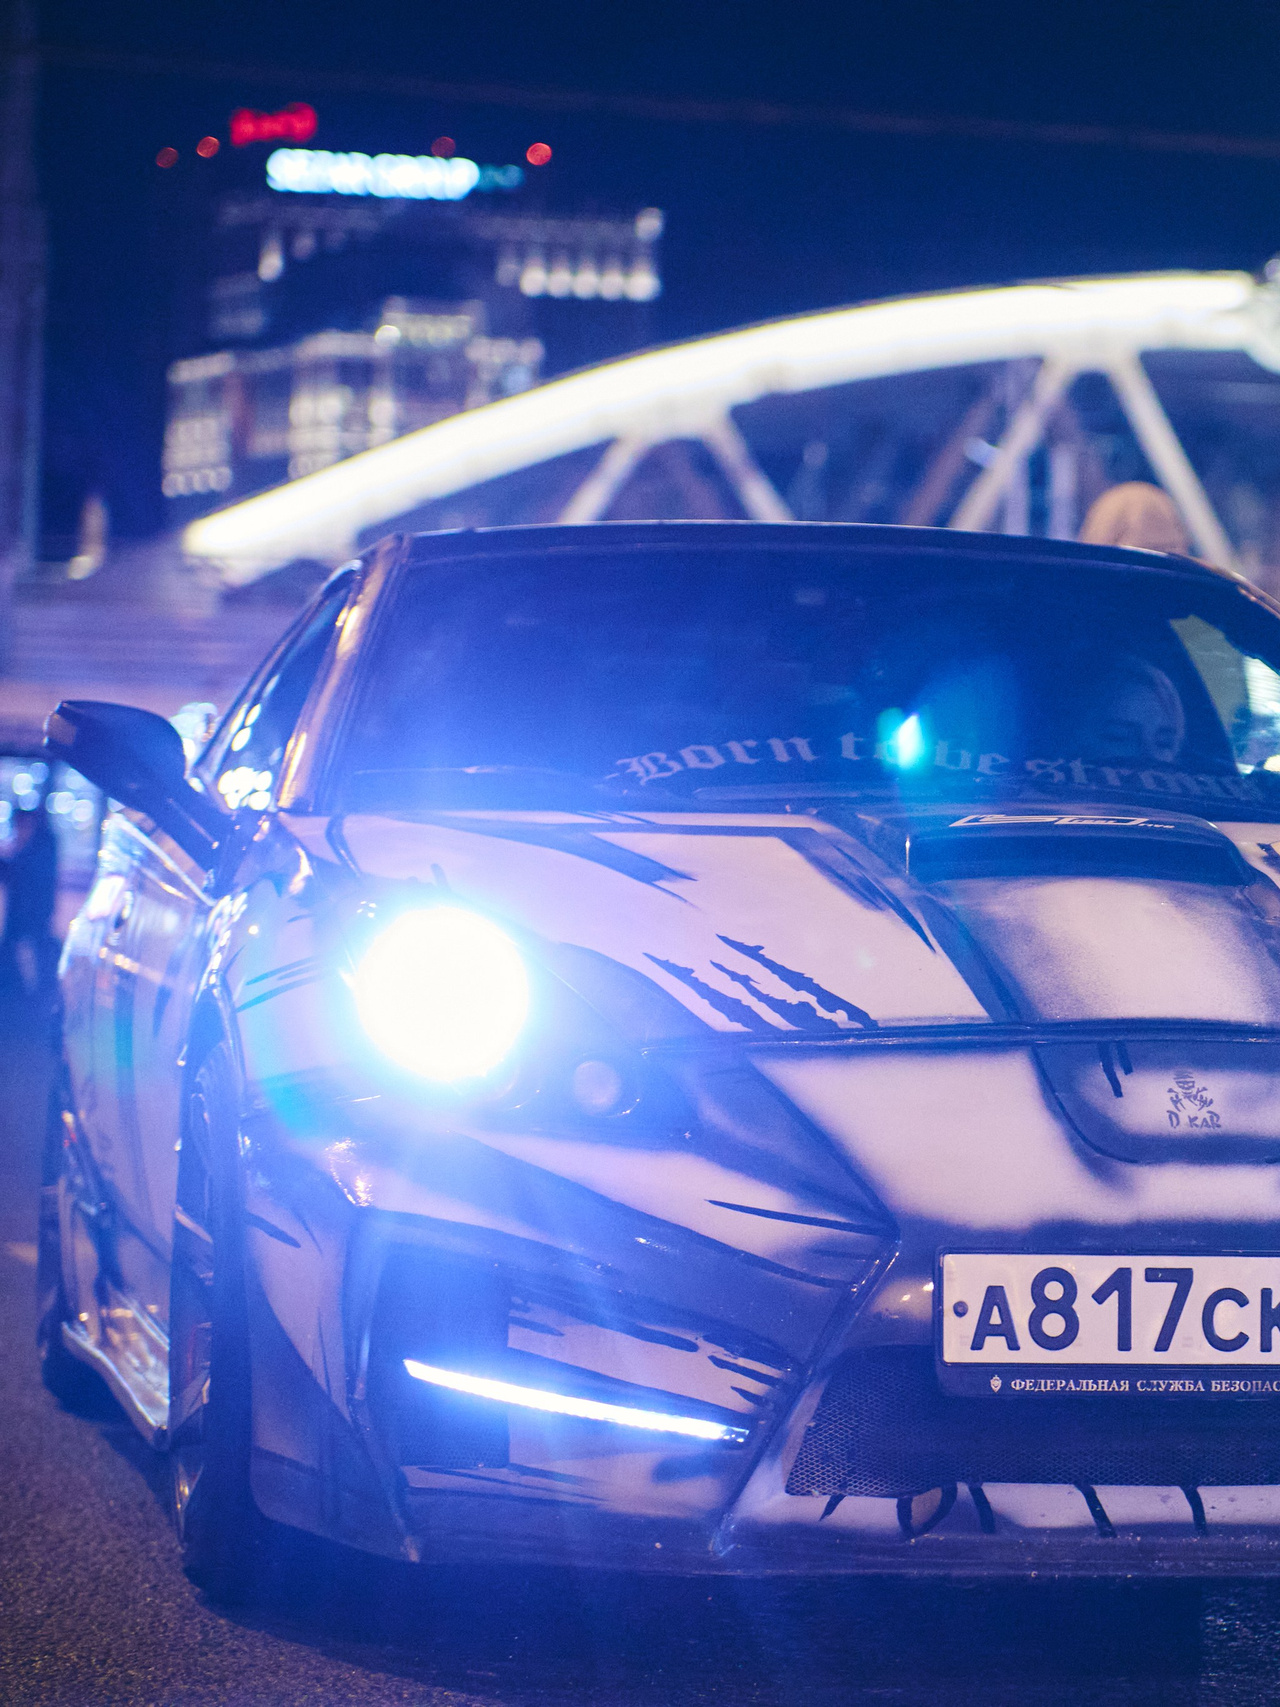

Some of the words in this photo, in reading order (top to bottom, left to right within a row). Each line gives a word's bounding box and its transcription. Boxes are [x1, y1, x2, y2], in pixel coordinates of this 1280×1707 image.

[605, 737, 818, 785] Born
[1010, 1378, 1130, 1393] ФЕДЕРАЛЬНАЯ
[1136, 1378, 1206, 1393] СЛУЖБА
